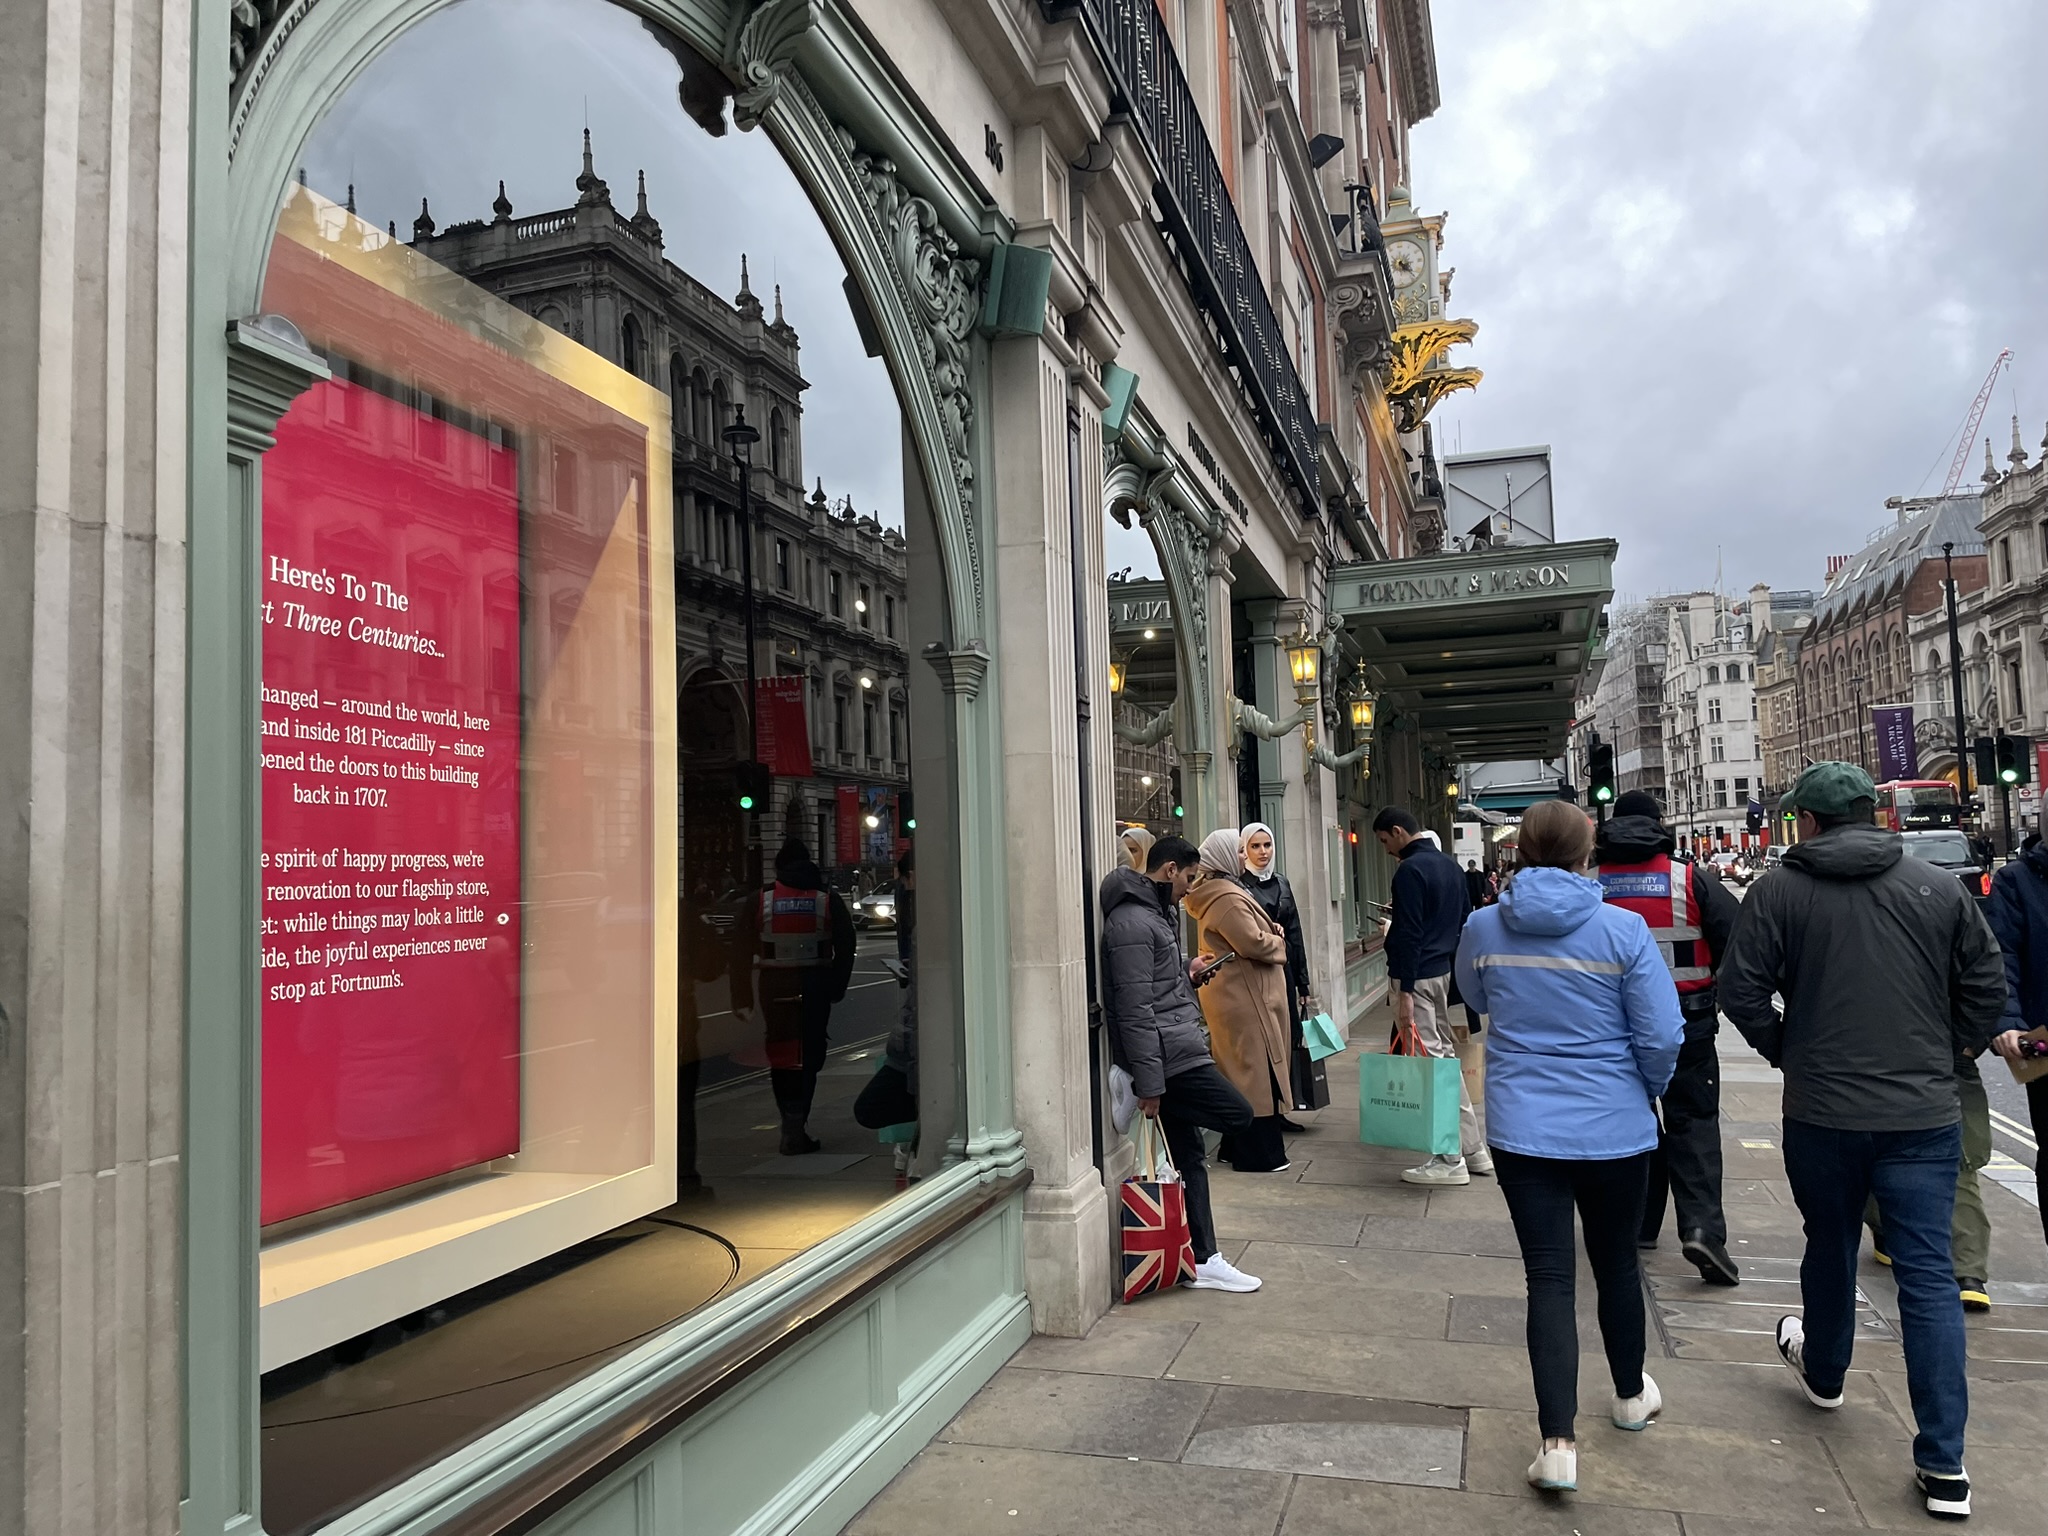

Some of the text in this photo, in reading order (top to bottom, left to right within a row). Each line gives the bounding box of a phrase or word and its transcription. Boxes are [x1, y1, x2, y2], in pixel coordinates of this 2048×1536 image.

[270, 556, 408, 611] Here's To The
[1359, 564, 1569, 605] FORTNUM & MASON
[283, 602, 341, 636] Three
[348, 617, 444, 657] Centuries...
[342, 699, 391, 718] around
[396, 703, 417, 721] the
[421, 709, 460, 729] world,
[464, 712, 489, 730] here
[261, 718, 289, 737] and
[295, 719, 340, 742] inside
[345, 726, 366, 745] 181
[372, 728, 436, 756] Piccadilly
[454, 739, 484, 757] since
[1888, 725, 1899, 760] ARCADE
[1894, 712, 1908, 771] BURLINGTON
[309, 753, 334, 773] the
[339, 755, 378, 776] doors
[383, 762, 397, 778] to
[401, 762, 426, 780] this
[430, 764, 478, 788] building
[293, 783, 387, 807] back in 1707.
[275, 848, 317, 872] spirit
[322, 848, 338, 867] of
[344, 848, 387, 871] happy
[391, 855, 449, 871] progress,
[453, 850, 484, 867] we're
[267, 879, 489, 901] renovation to our flagship store,
[1610, 876, 1658, 885] COMMUNITY
[1633, 884, 1665, 893] OFFICER
[284, 912, 327, 932] while
[332, 911, 377, 933] things
[382, 914, 410, 931] may
[414, 908, 441, 925] look
[445, 912, 452, 924] a
[456, 906, 483, 923] little
[295, 945, 320, 965] the
[325, 941, 368, 967] joyful
[373, 938, 450, 962] experiences
[454, 938, 487, 951] never
[271, 969, 403, 1002] stop at Fortnum's.
[1371, 1097, 1396, 1107] FORTNUM
[1402, 1101, 1420, 1110] MASON
